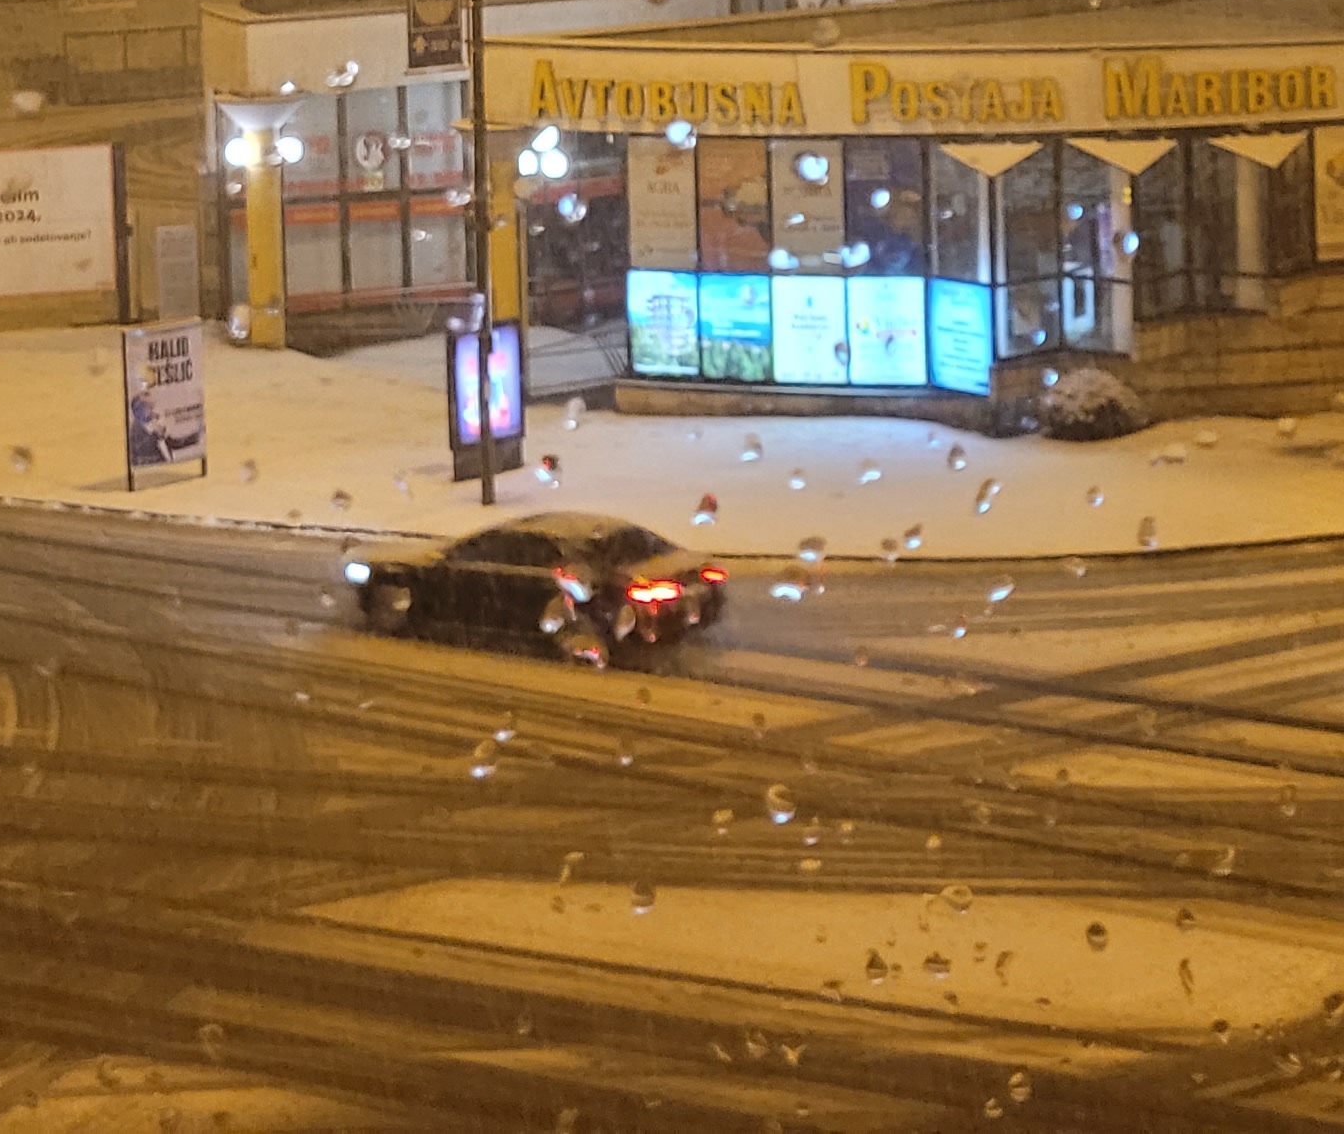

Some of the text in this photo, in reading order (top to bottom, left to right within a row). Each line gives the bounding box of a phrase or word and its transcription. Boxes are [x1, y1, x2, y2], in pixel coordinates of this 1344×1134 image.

[530, 54, 1338, 126] AVTOBUSNA POSTAJA MARIBOR
[148, 335, 190, 361] HALID
